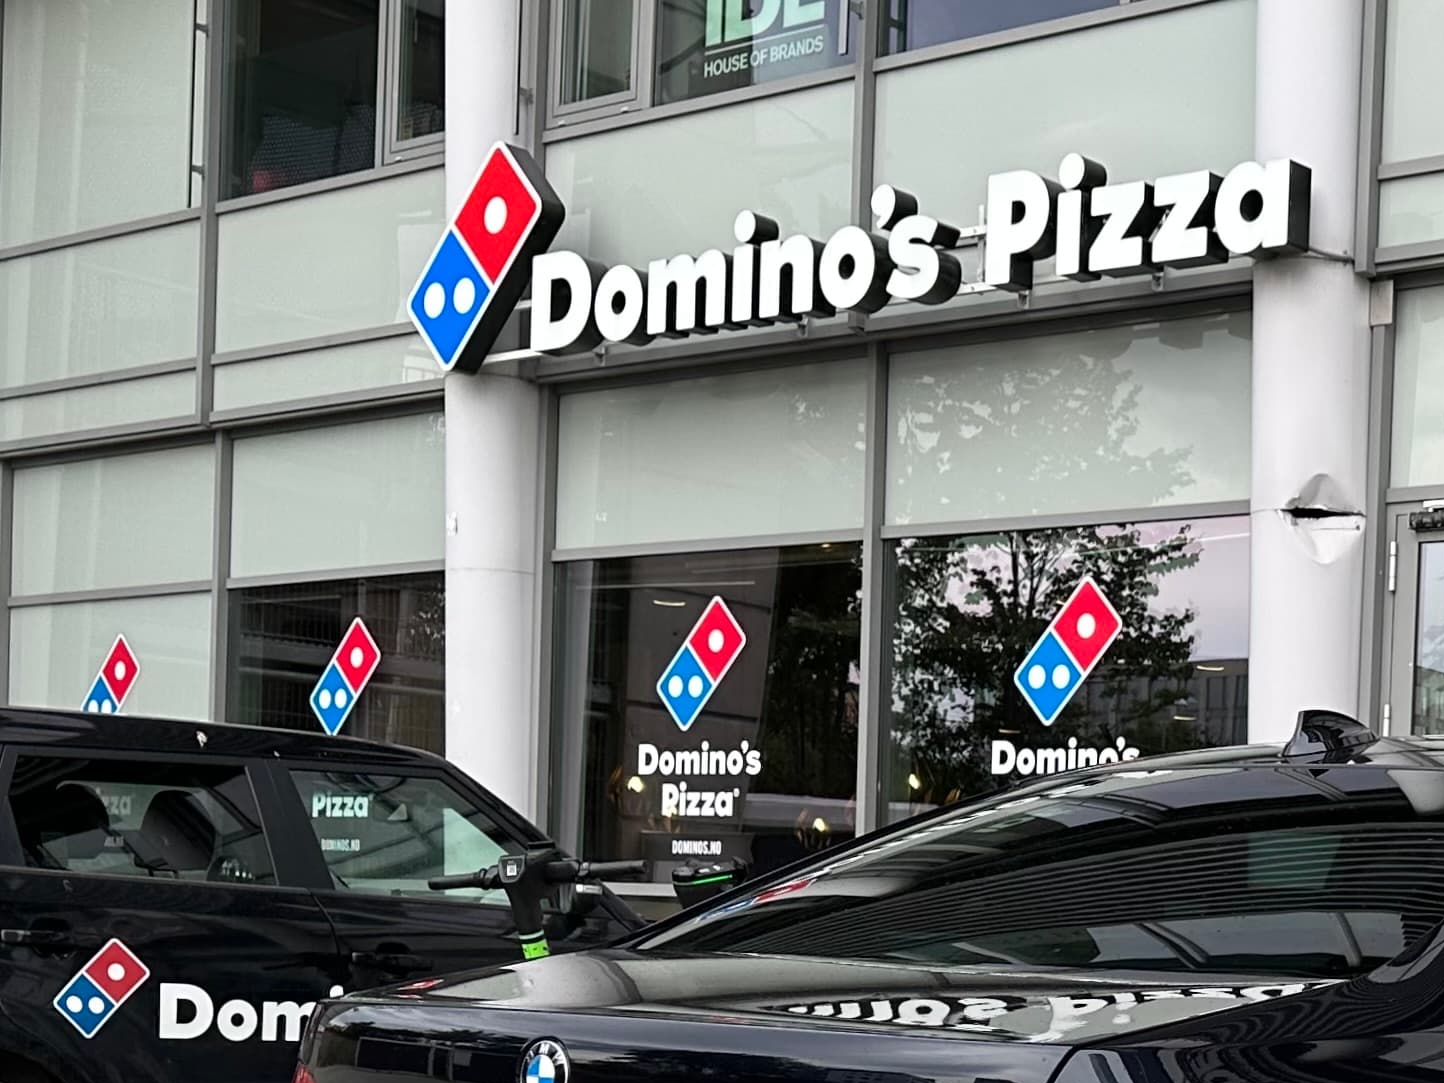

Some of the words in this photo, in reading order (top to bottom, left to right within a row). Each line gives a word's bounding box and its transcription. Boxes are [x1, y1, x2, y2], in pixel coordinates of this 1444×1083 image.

[704, 53, 748, 78] HOUSE
[751, 50, 767, 66] OF
[770, 36, 824, 62] BRANDS
[530, 183, 942, 354] Domino's
[985, 153, 1294, 287] Pizza
[637, 740, 762, 775] Domino's
[312, 791, 370, 818] Pizza
[661, 781, 735, 817] Pizza
[672, 840, 722, 855] DOMINOS.NO
